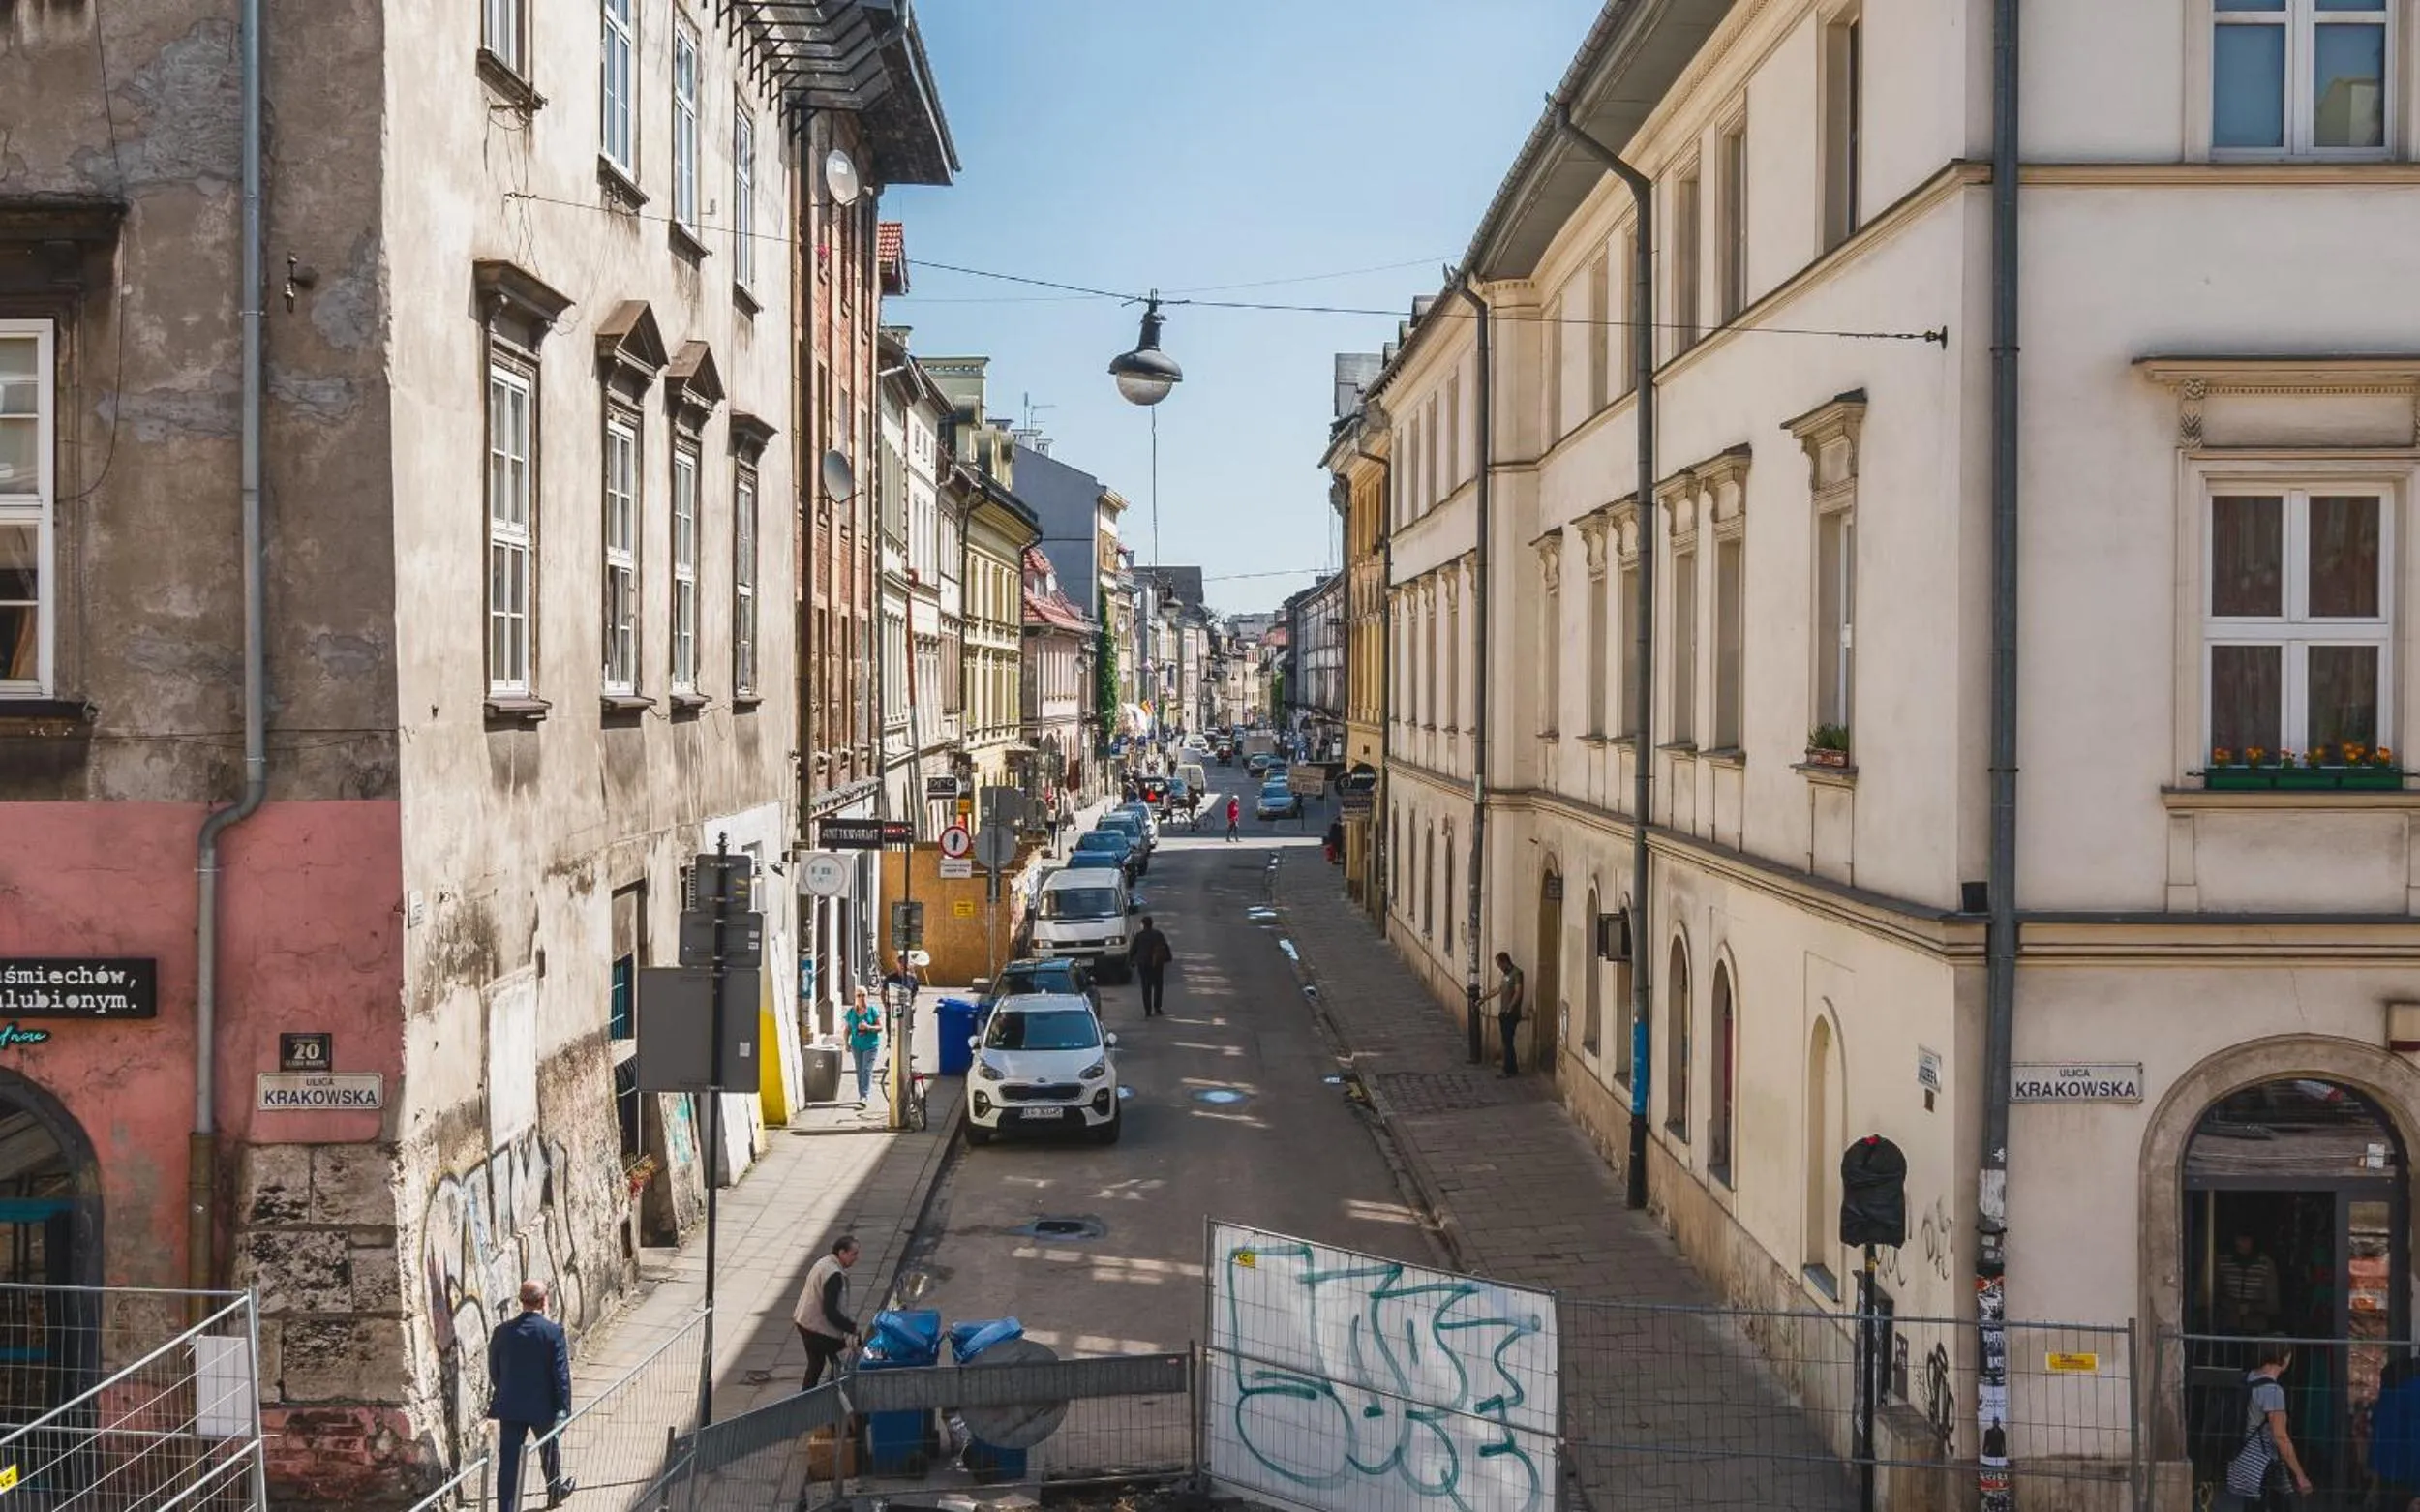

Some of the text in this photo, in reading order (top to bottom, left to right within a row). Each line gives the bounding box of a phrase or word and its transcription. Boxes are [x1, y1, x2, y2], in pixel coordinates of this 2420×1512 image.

[0, 965, 137, 988] śmiechów,
[0, 989, 137, 1013] lubionym.
[293, 1043, 320, 1060] 20
[2059, 1068, 2091, 1077] ULICA
[305, 1077, 335, 1086] ULICA
[2015, 1081, 2136, 1097] KRAKOWSKA
[264, 1090, 377, 1104] KRAKOWSKA
